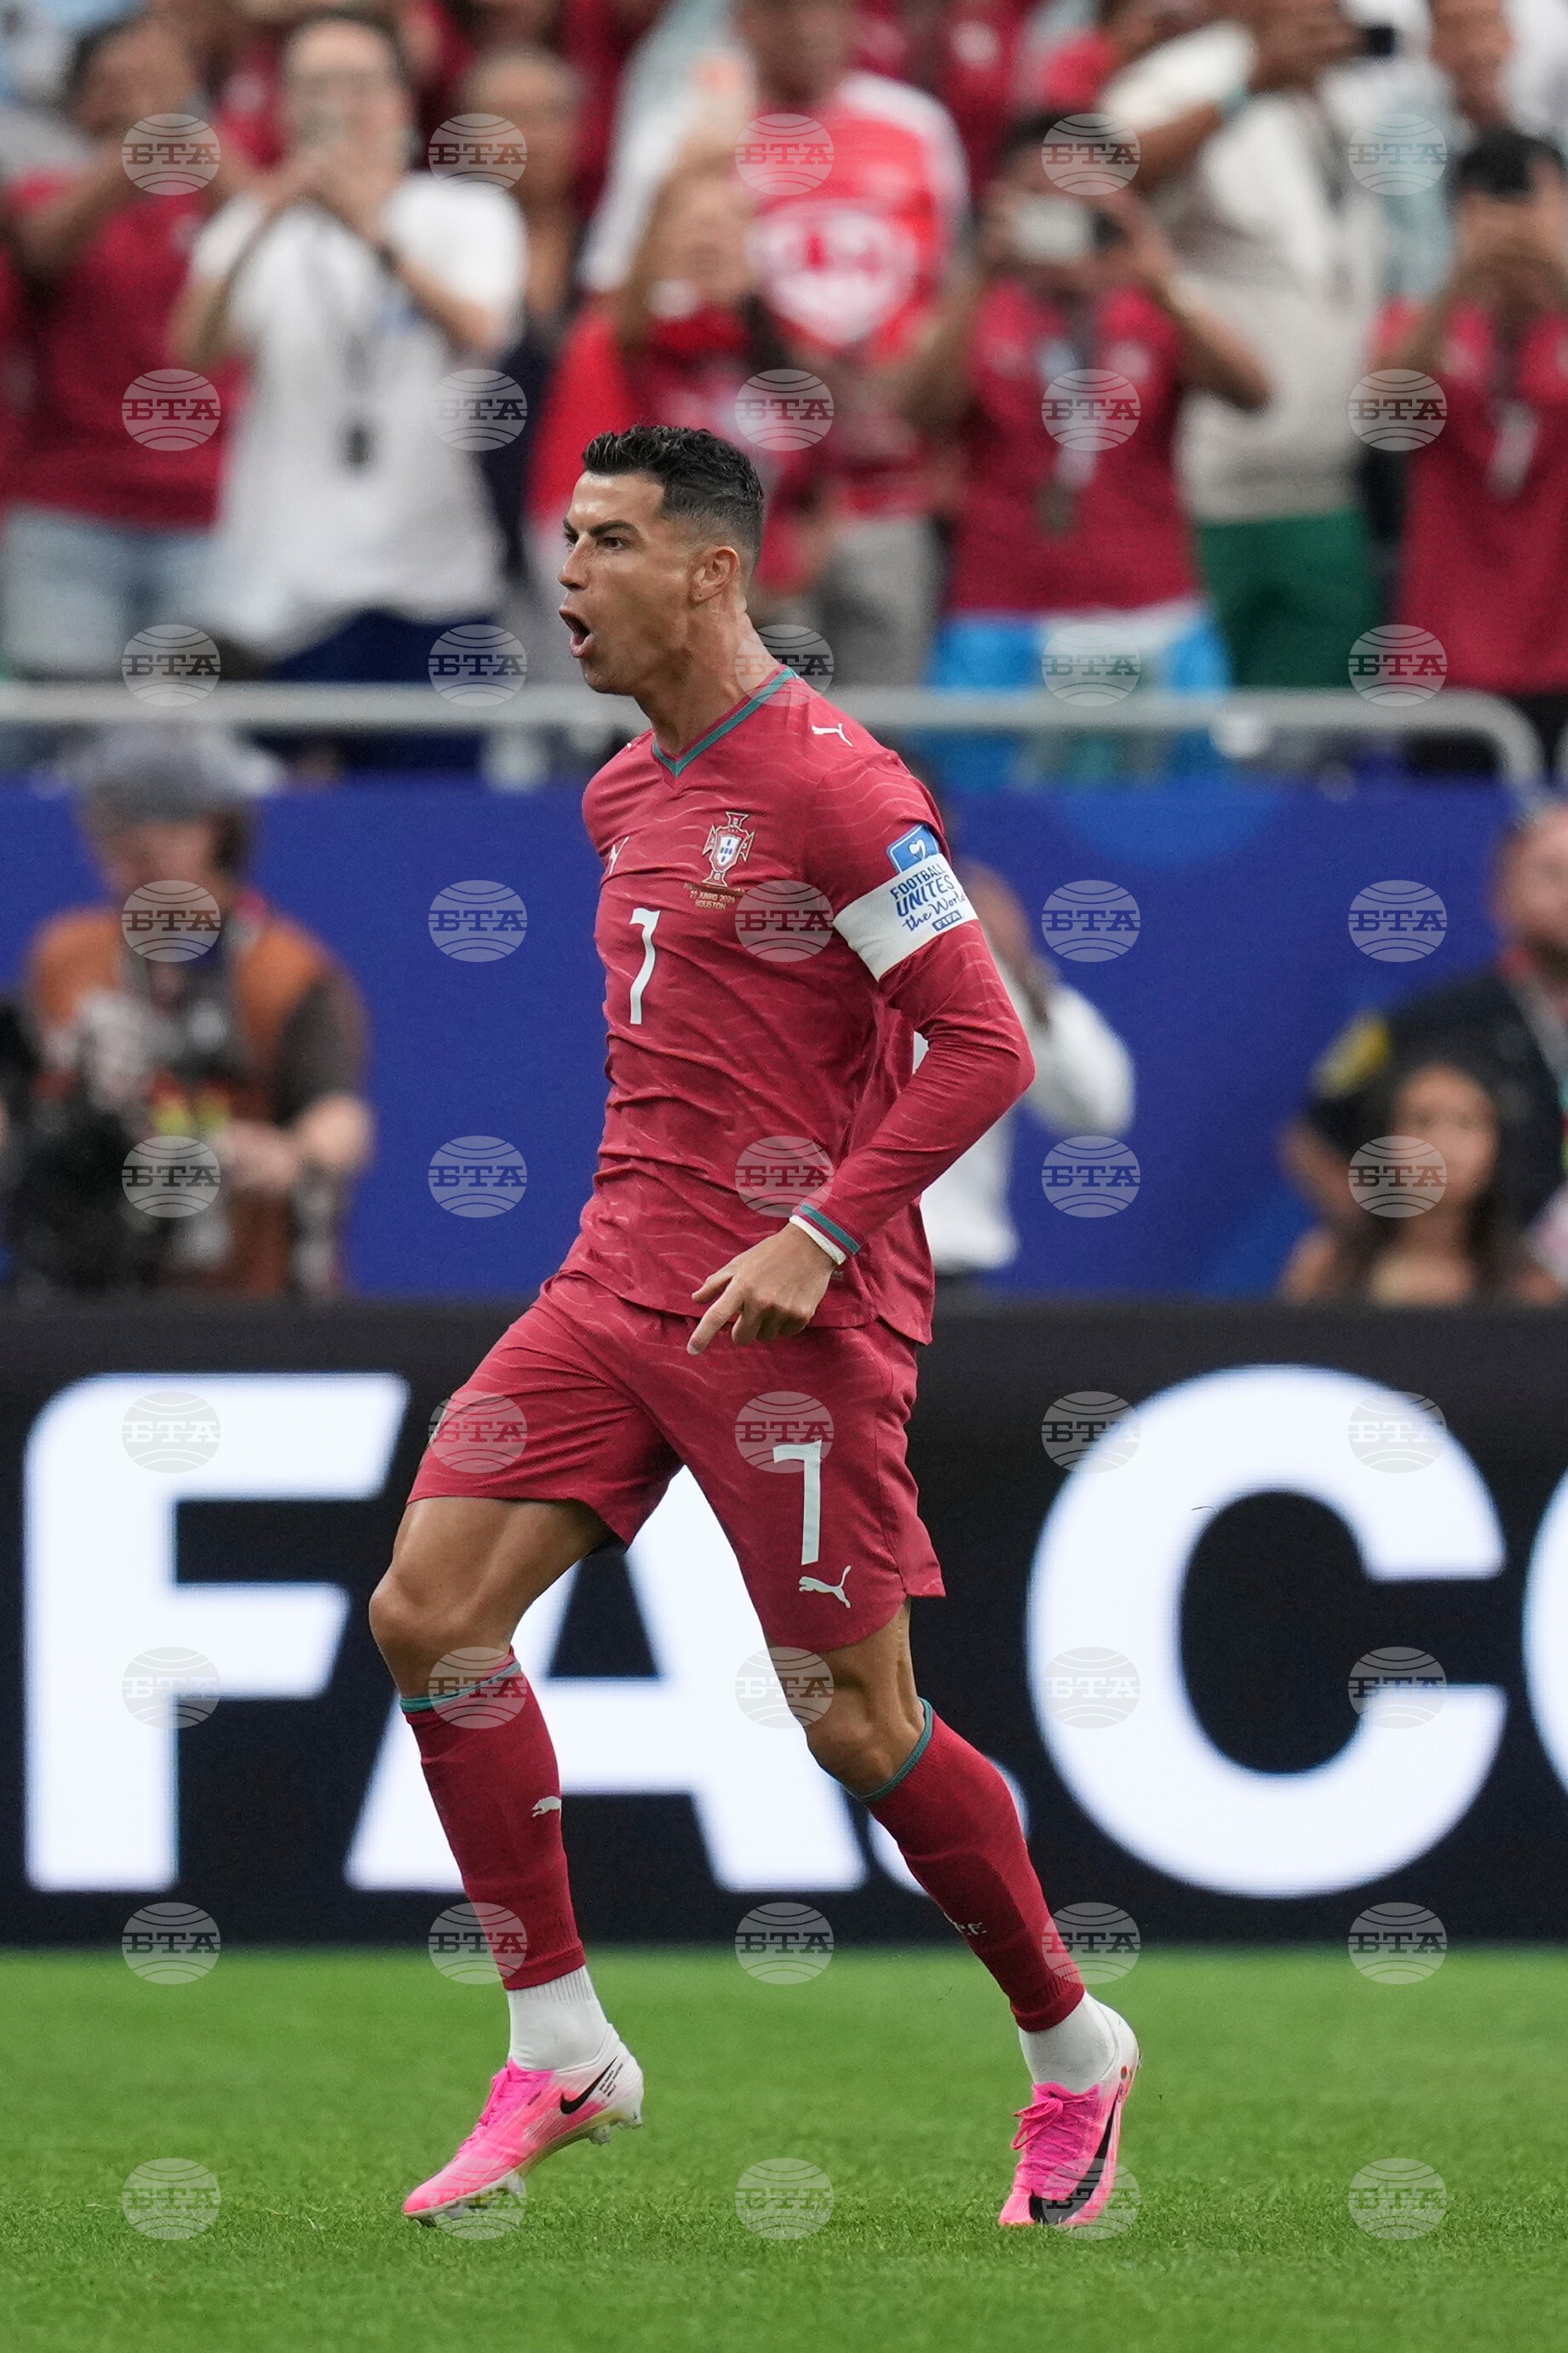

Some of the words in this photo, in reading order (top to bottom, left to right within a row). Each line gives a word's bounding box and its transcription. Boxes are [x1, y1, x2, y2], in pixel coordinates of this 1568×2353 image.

[890, 864, 946, 900] FOOTBALL
[896, 875, 955, 917] UNITES
[902, 913, 932, 931] the
[629, 907, 661, 1025] 7
[773, 1439, 822, 1565] 7
[22, 1365, 1568, 1900] FAC
